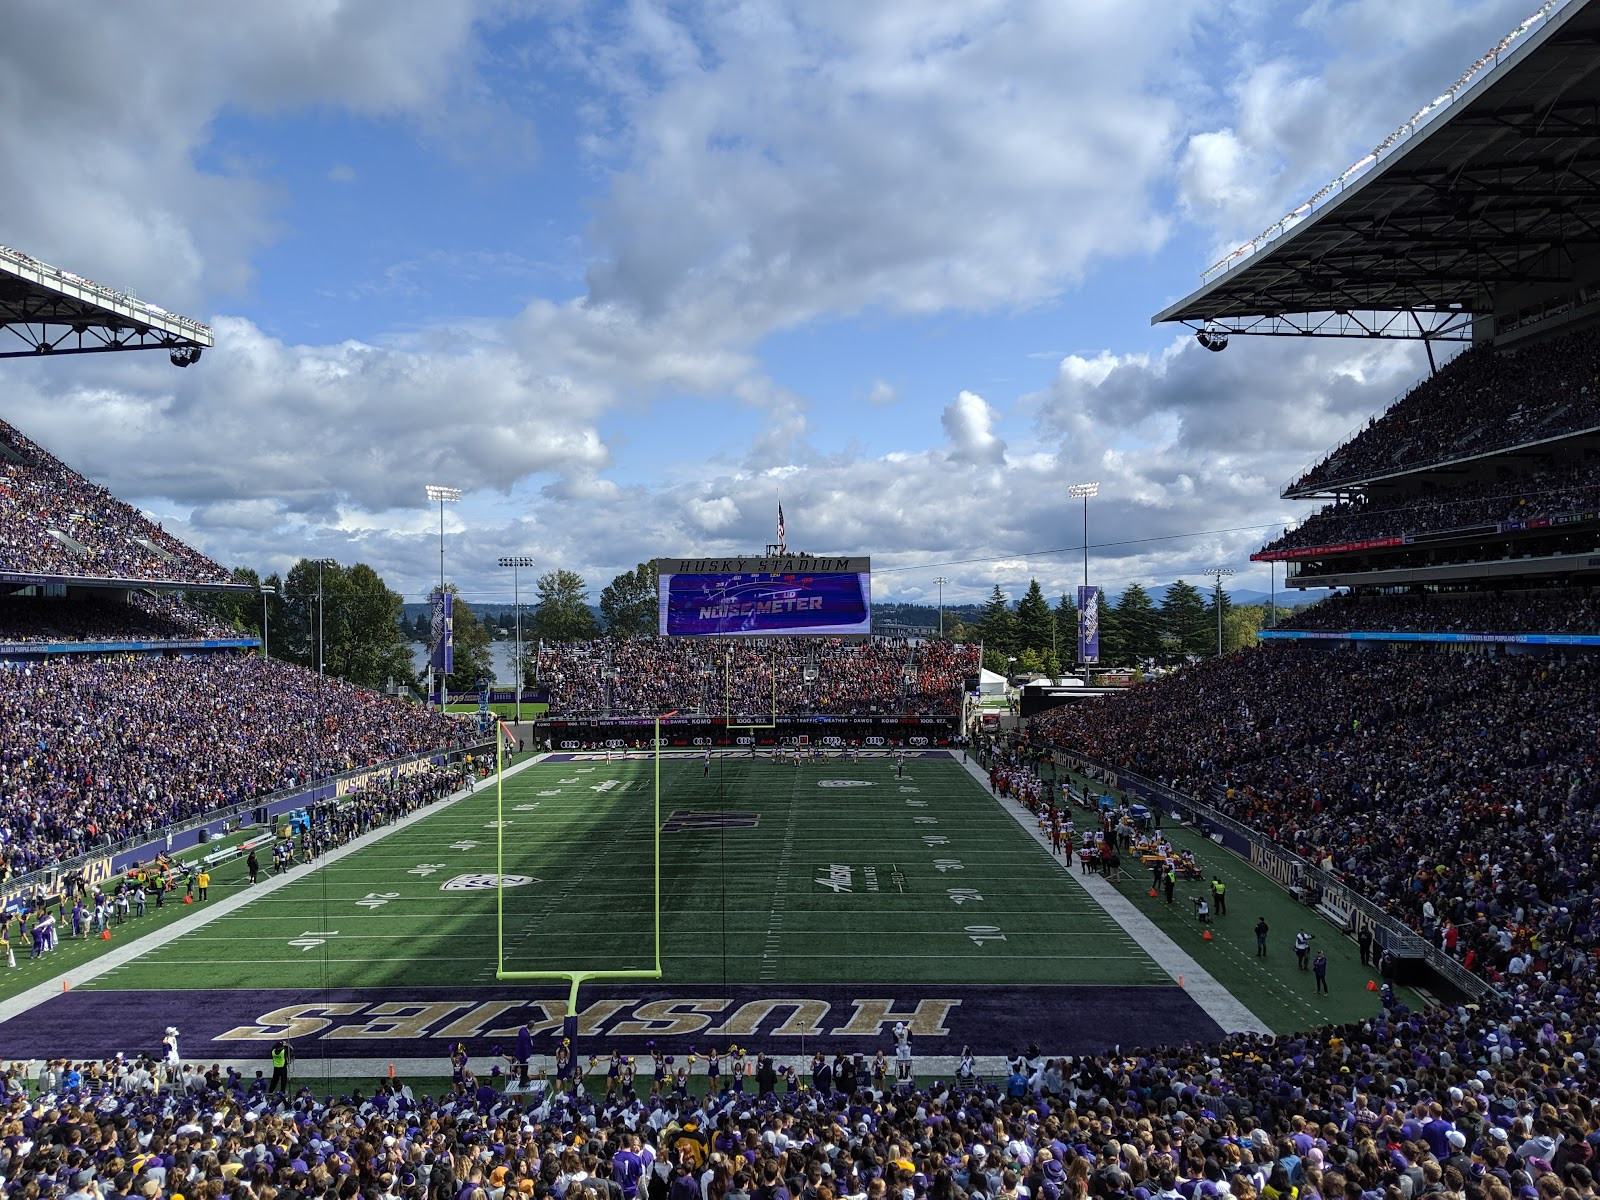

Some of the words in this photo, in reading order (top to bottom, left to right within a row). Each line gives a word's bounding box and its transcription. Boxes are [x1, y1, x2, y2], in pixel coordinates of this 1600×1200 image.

[679, 560, 748, 572] HUSKY
[758, 559, 850, 571] STADIUM
[773, 591, 796, 599] LUD
[756, 596, 823, 615] METER
[336, 767, 393, 798] WASHINON
[397, 757, 431, 779] HUSKIES
[355, 892, 400, 907] 20
[946, 888, 984, 901] 20
[288, 930, 339, 948] 10
[964, 925, 1008, 942] 10
[211, 999, 962, 1041] HUSKIES
